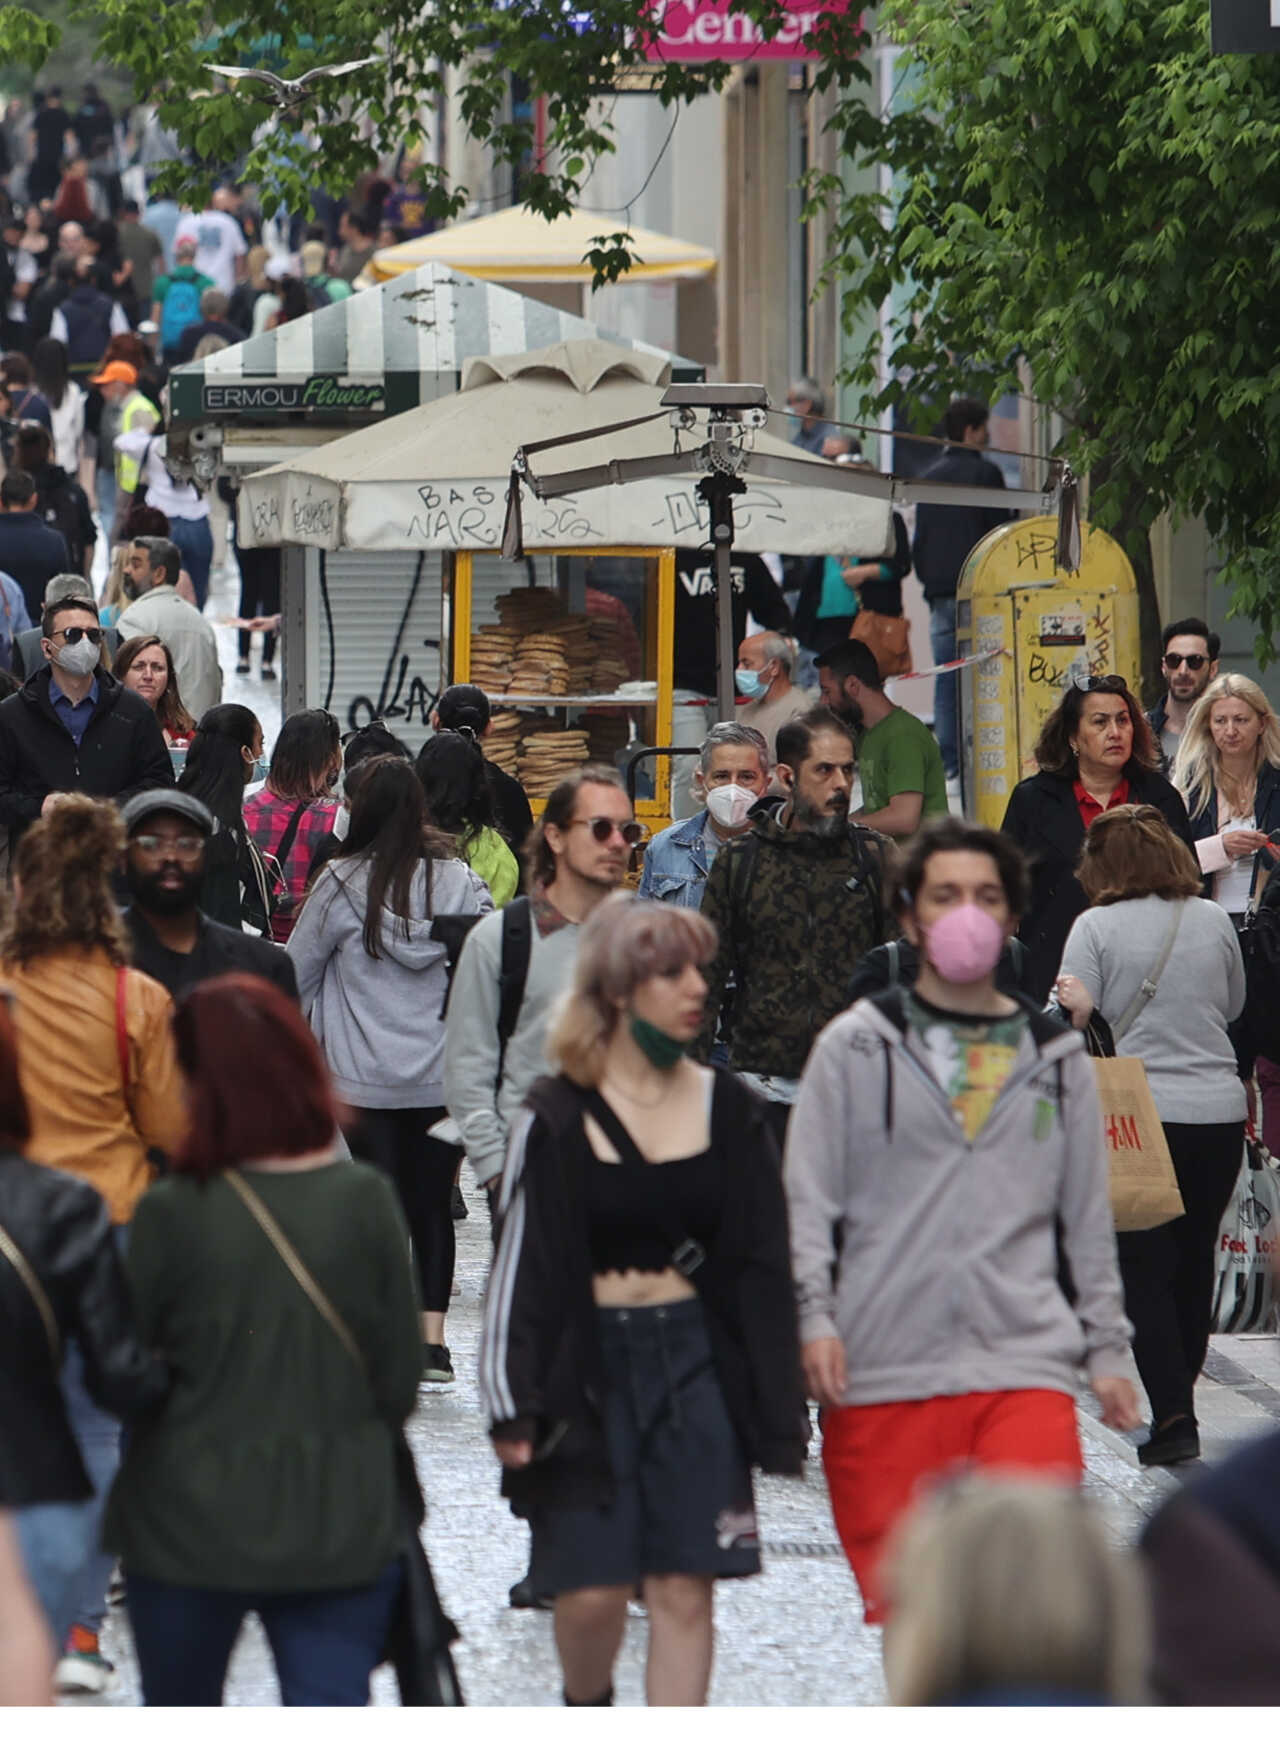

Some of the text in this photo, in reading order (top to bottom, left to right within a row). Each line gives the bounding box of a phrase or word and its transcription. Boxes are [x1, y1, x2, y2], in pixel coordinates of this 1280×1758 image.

[652, 0, 820, 44] Cener
[207, 377, 382, 407] ERMOU Flower
[680, 566, 746, 597] VAS
